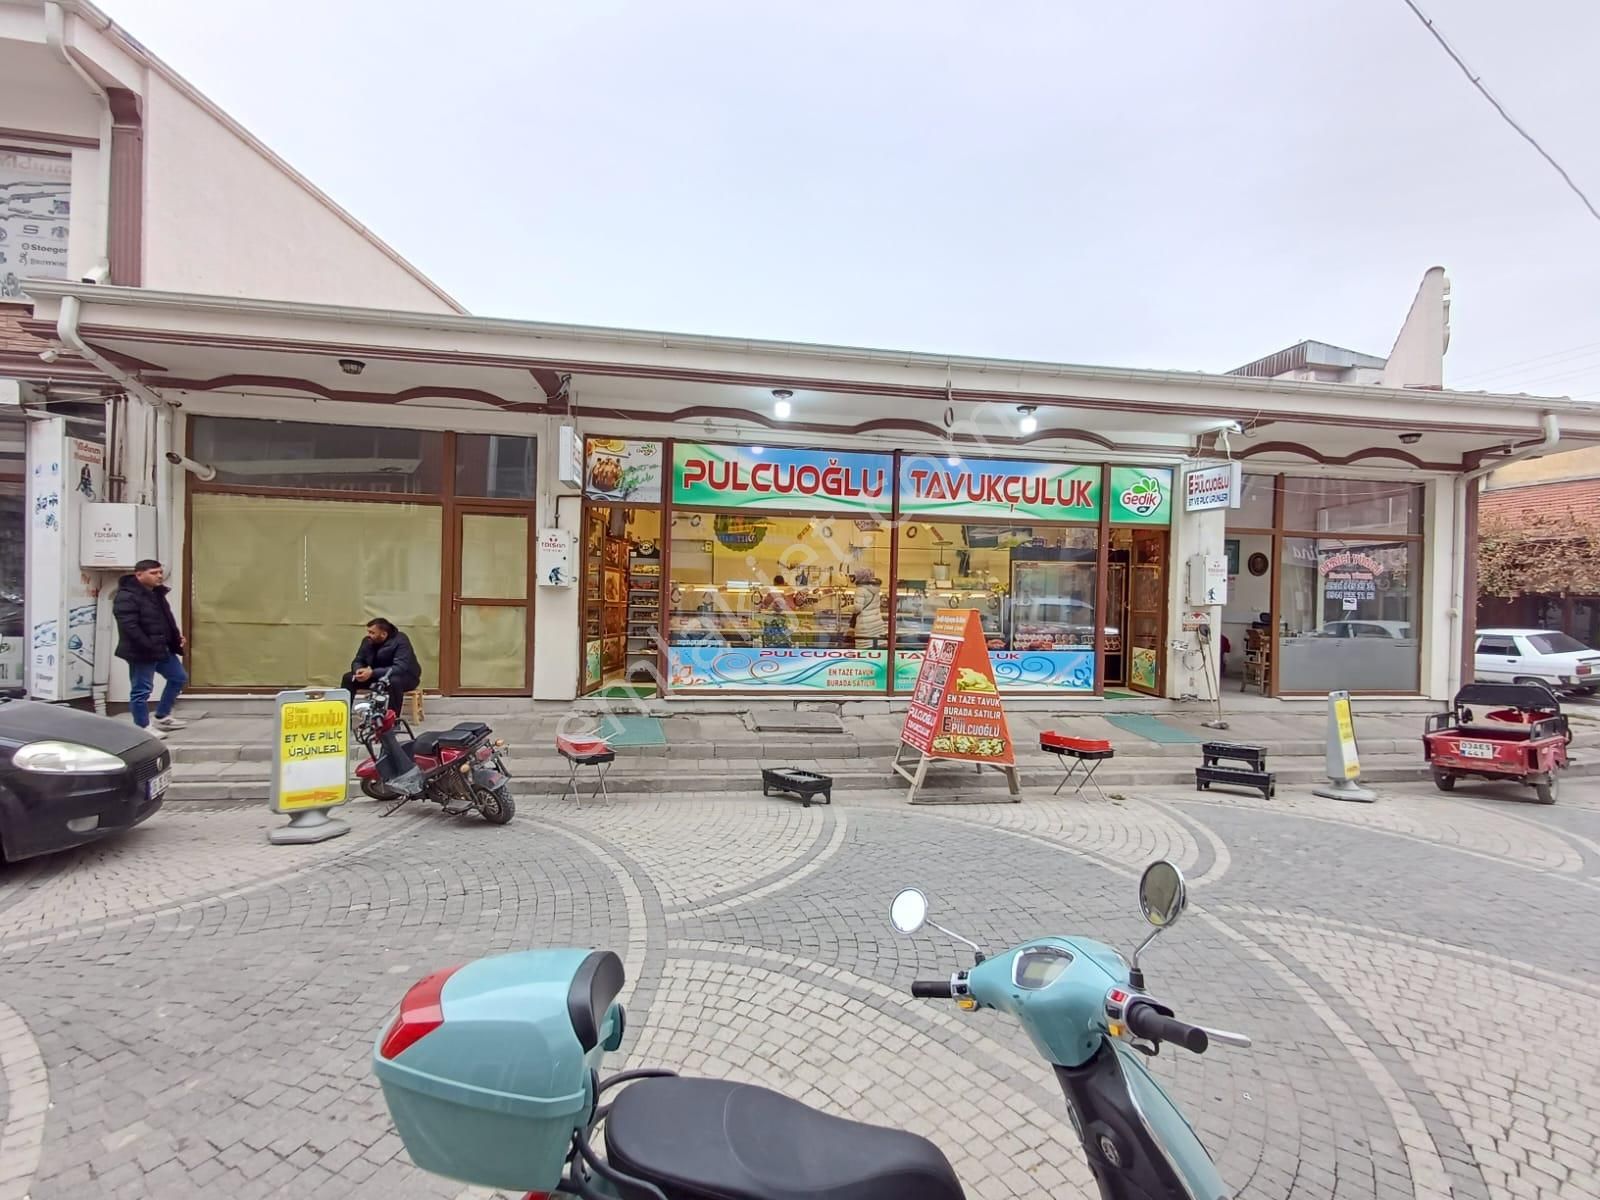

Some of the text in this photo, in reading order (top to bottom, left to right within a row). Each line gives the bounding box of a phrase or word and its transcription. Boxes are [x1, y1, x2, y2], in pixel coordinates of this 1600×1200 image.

[683, 458, 884, 498] PULCUOĞLU
[910, 470, 1093, 513] TAVUKÇULUK
[1122, 491, 1158, 506] Gedik
[946, 694, 1001, 708] EN TAZE TAVUK
[943, 706, 1001, 720] BURADA SATILIR
[285, 734, 298, 744] ET
[302, 732, 316, 742] VE
